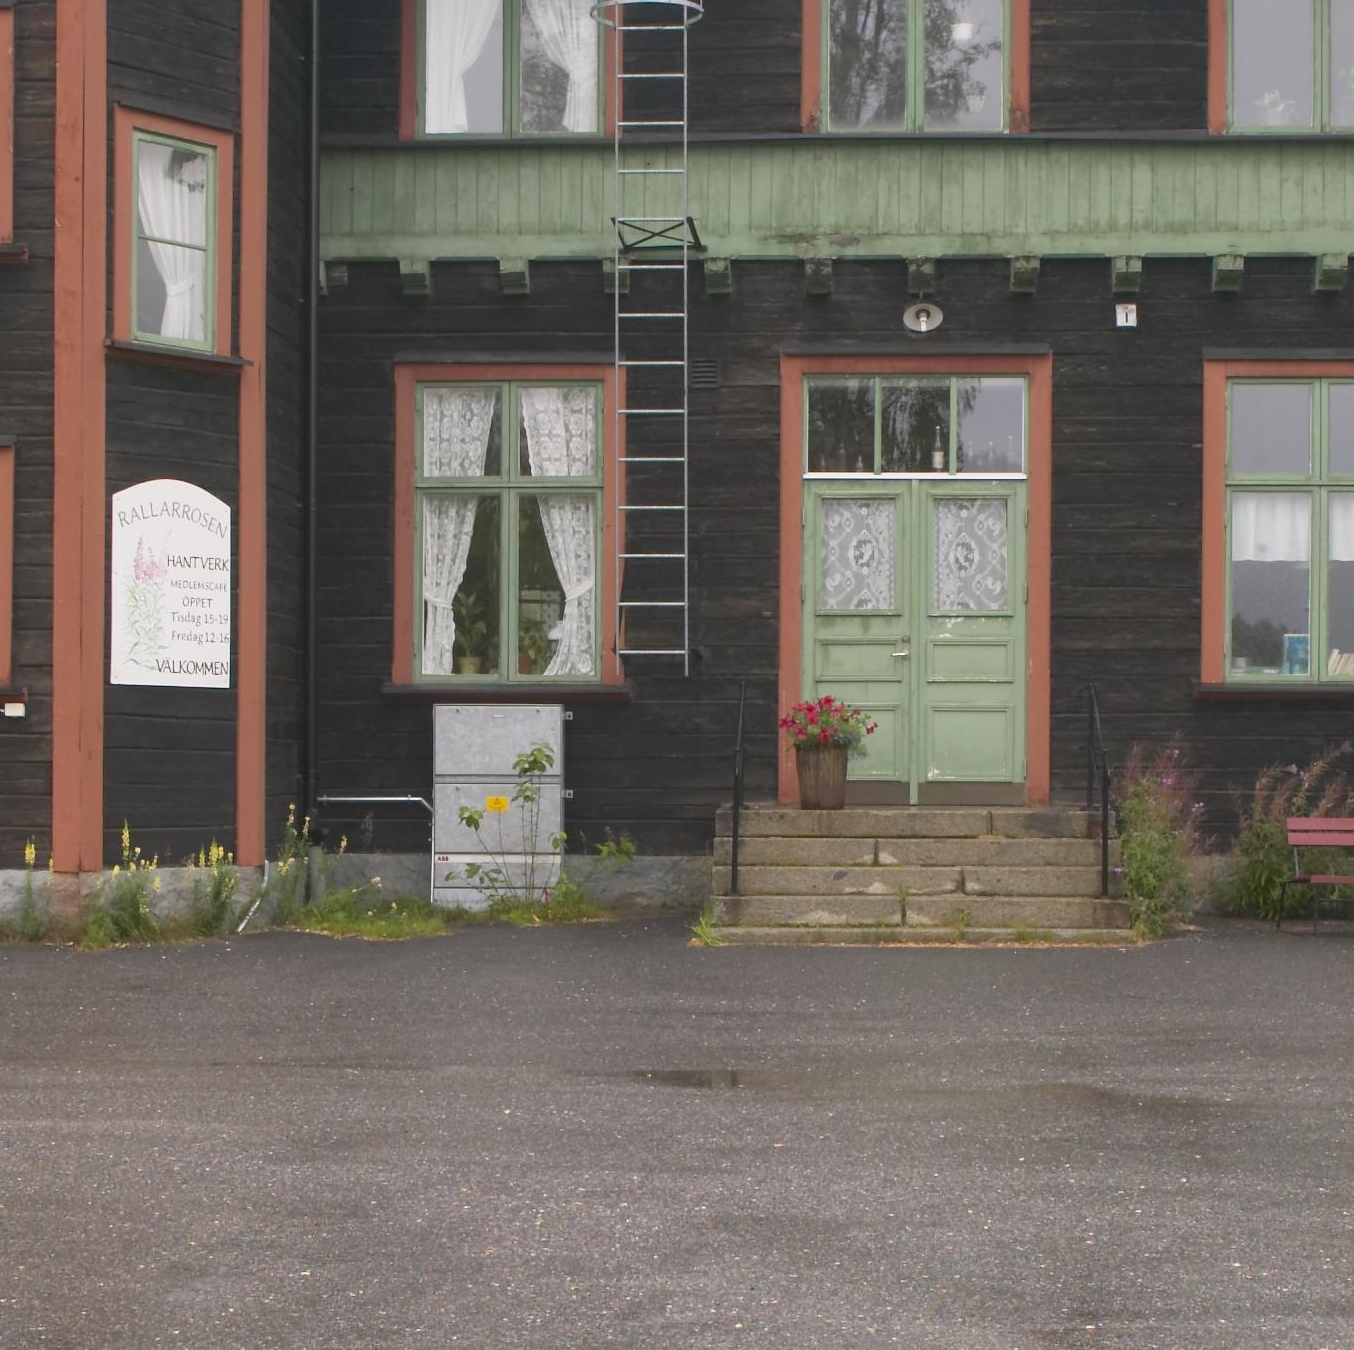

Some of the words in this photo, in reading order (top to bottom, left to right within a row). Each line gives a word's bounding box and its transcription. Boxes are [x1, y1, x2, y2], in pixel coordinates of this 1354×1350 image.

[118, 501, 228, 538] RALLARROSEN
[167, 554, 229, 572] HANTVERK
[182, 595, 213, 608] ÖPPET
[170, 611, 202, 626] Tisdag
[204, 613, 229, 625] 15-19
[171, 630, 203, 645] Fredag
[205, 632, 230, 643] 12-16
[155, 656, 229, 676] VÄLKOMMEN
